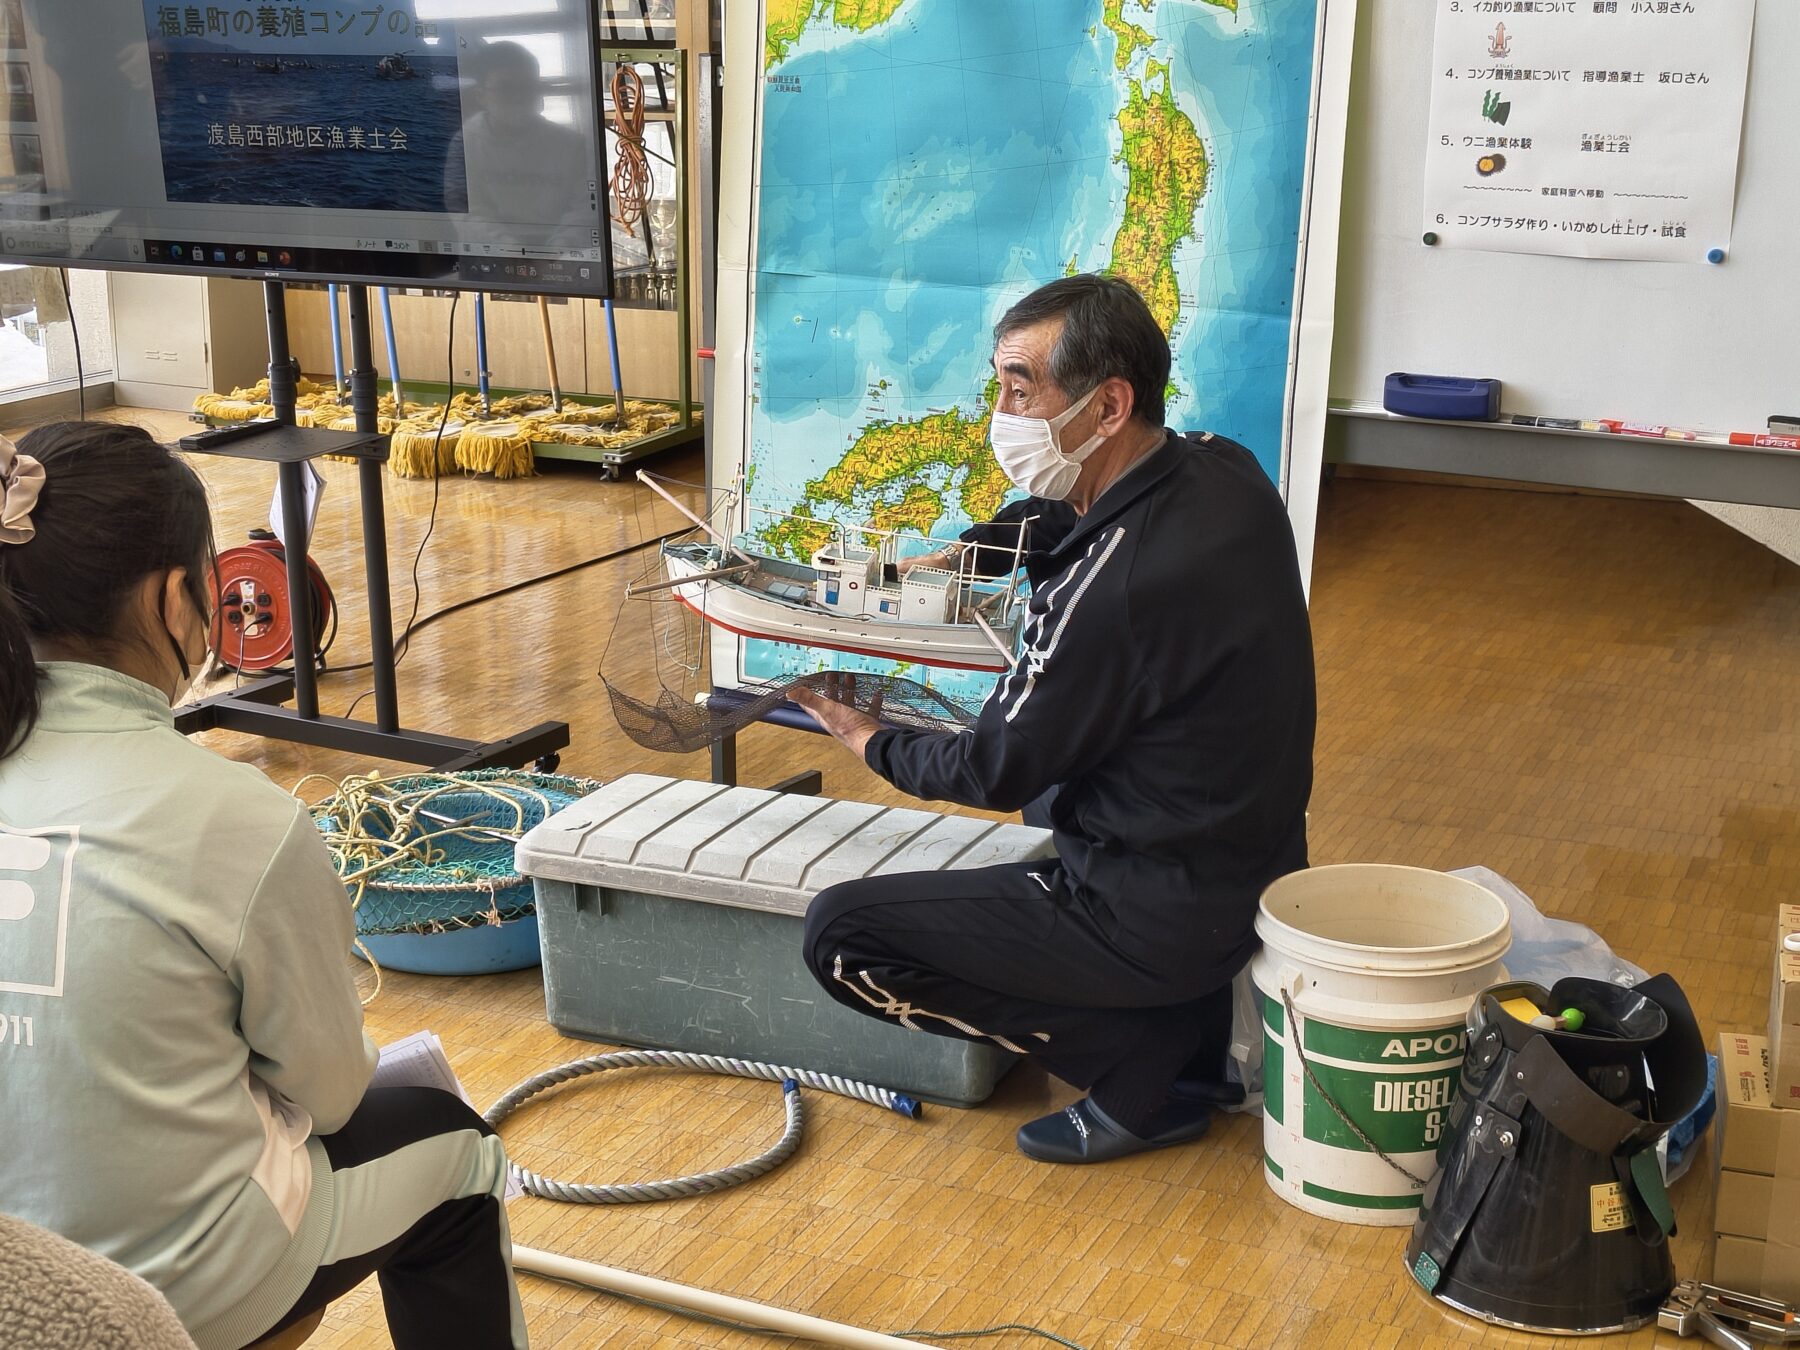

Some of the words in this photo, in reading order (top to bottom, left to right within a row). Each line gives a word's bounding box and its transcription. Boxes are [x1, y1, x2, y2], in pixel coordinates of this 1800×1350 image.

[1592, 1, 1618, 14] 顧問
[1630, 1, 1695, 14] 小入羽さん
[1582, 71, 1645, 83] 指導漁業士
[1658, 71, 1710, 84] 坂口さん
[207, 123, 408, 150] 渡島西部地区漁業士会
[1462, 135, 1533, 149] ウニ漁業体験
[1580, 140, 1630, 153] 漁業士会
[1373, 1076, 1451, 1112] DIESEL
